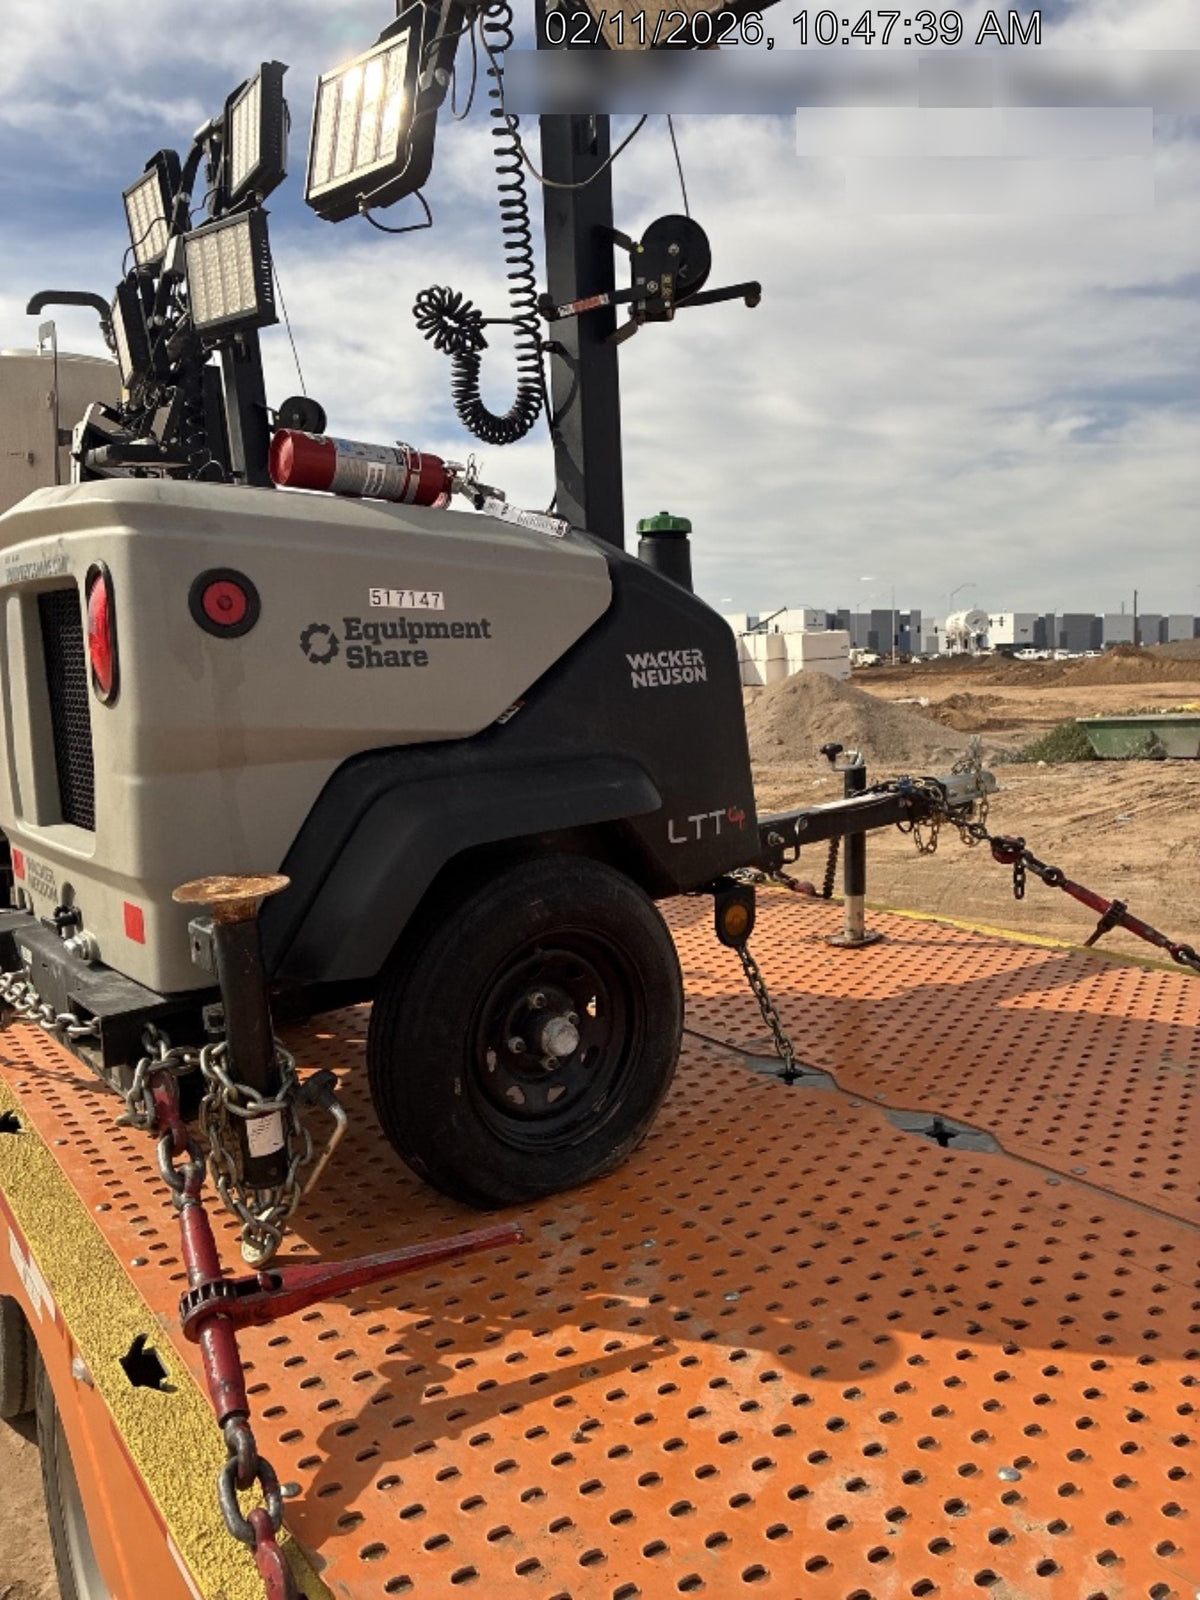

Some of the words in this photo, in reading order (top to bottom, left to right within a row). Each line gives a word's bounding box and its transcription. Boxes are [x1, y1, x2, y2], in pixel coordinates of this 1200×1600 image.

[370, 589, 441, 608] 517147
[343, 617, 492, 645] Equipment
[346, 645, 429, 669] Share
[625, 648, 705, 670] WACKER
[630, 666, 708, 689] NEUSON
